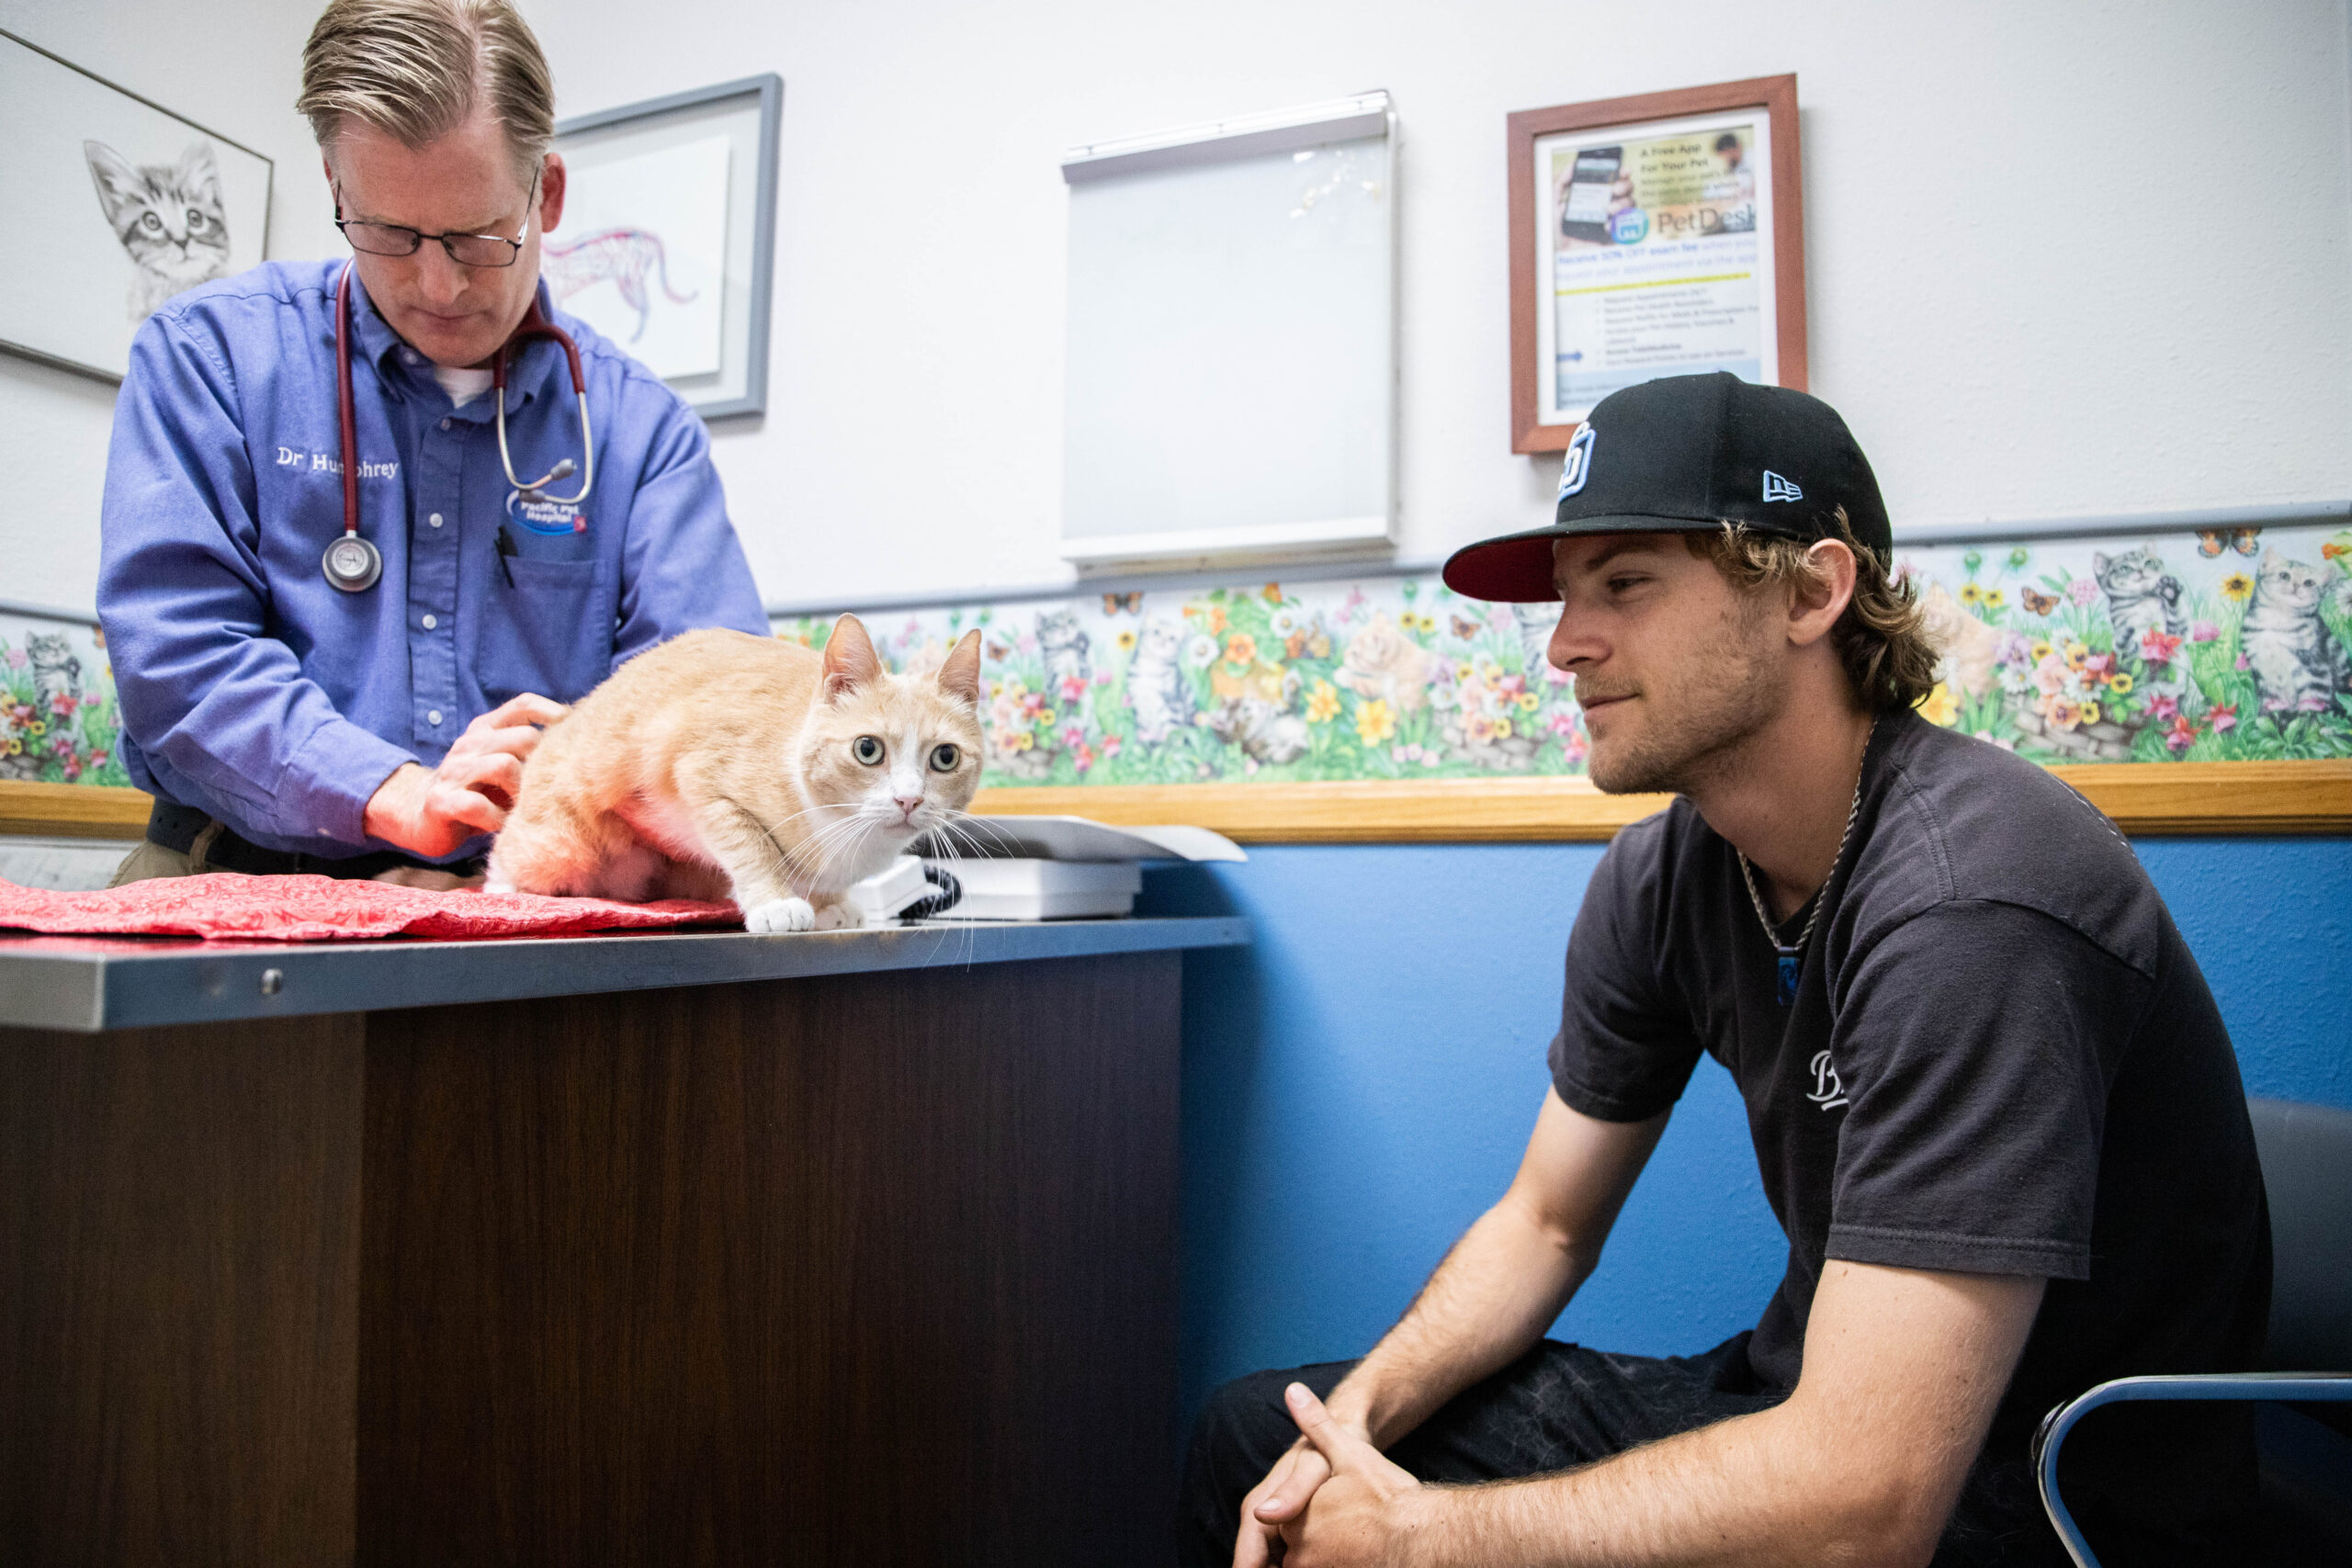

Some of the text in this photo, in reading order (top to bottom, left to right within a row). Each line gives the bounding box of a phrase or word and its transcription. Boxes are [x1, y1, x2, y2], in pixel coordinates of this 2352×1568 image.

[1640, 142, 1702, 158] A Free App
[1640, 157, 1709, 174] For Your Pet
[277, 446, 304, 466] Dr
[560, 503, 580, 515] Pet
[526, 511, 572, 525] Hospital
